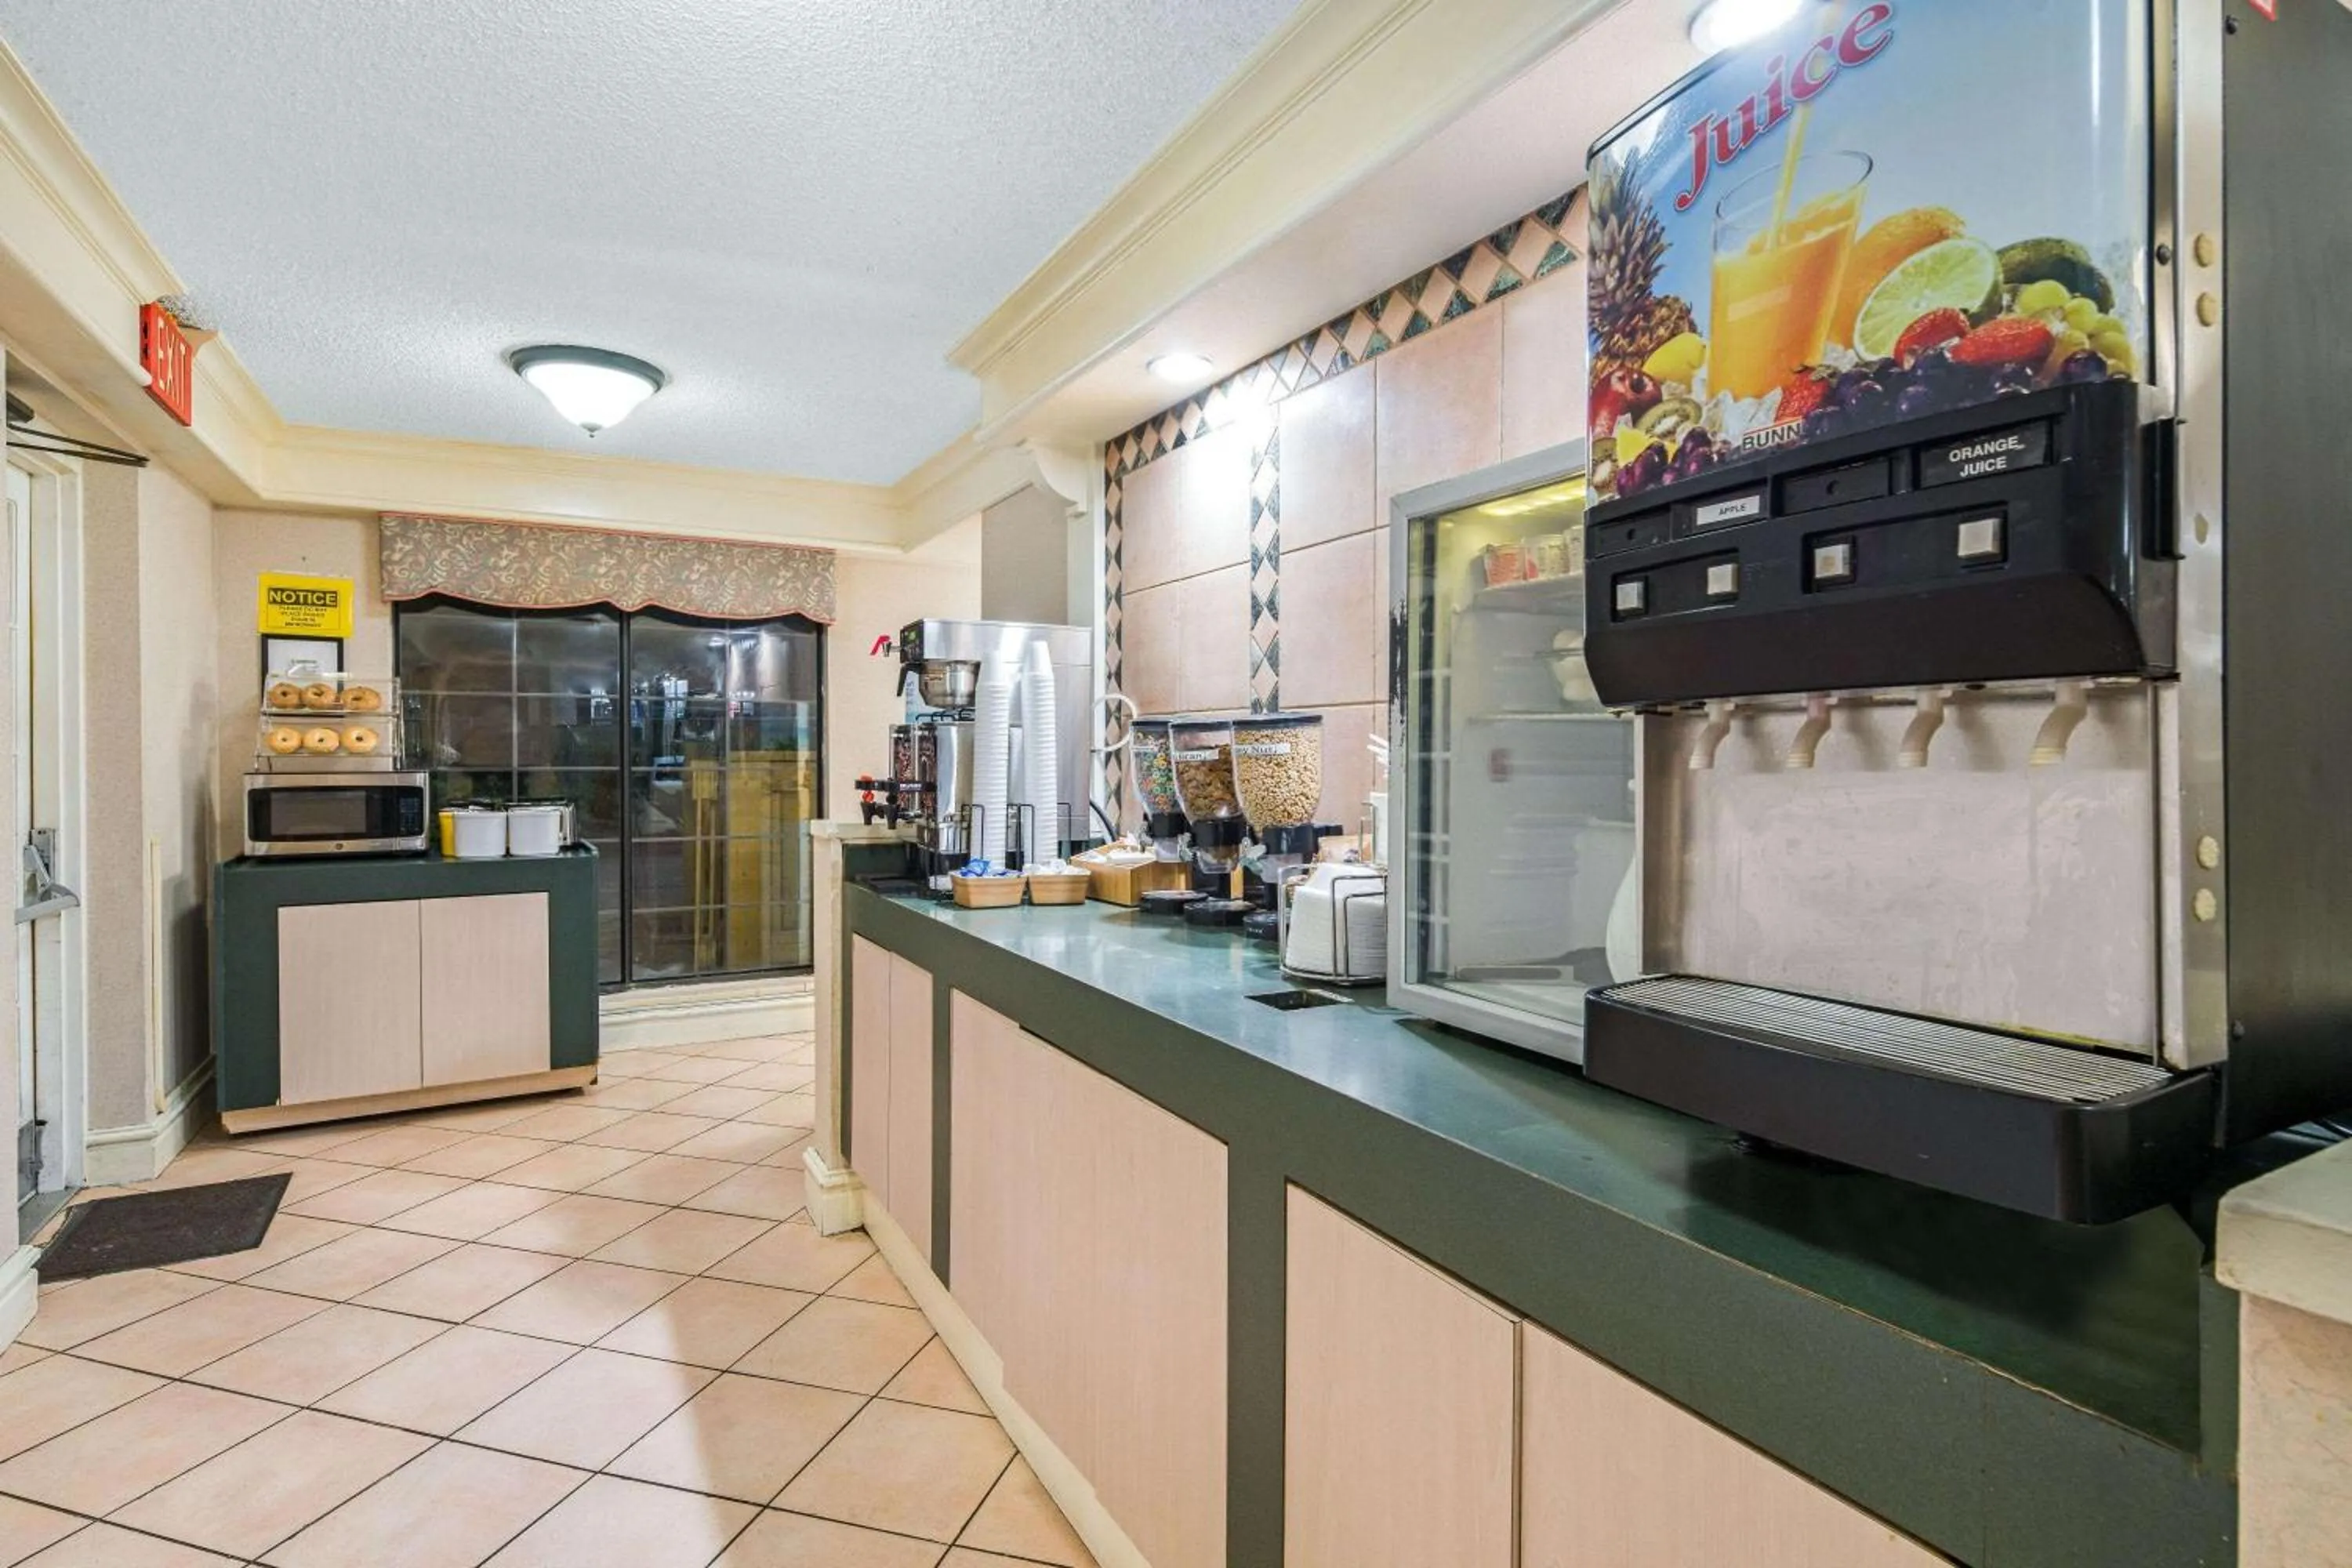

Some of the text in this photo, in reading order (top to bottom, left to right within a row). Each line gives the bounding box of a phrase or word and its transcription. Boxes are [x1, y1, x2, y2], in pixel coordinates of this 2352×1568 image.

[1674, 2, 1895, 212] Juice
[157, 315, 187, 414] EXIT
[1742, 423, 1801, 452] BUNN
[1948, 435, 2020, 463] ORANGE
[1959, 456, 2008, 477] JUICE
[1718, 503, 1748, 517] APPLE
[268, 590, 337, 606] NOTICE
